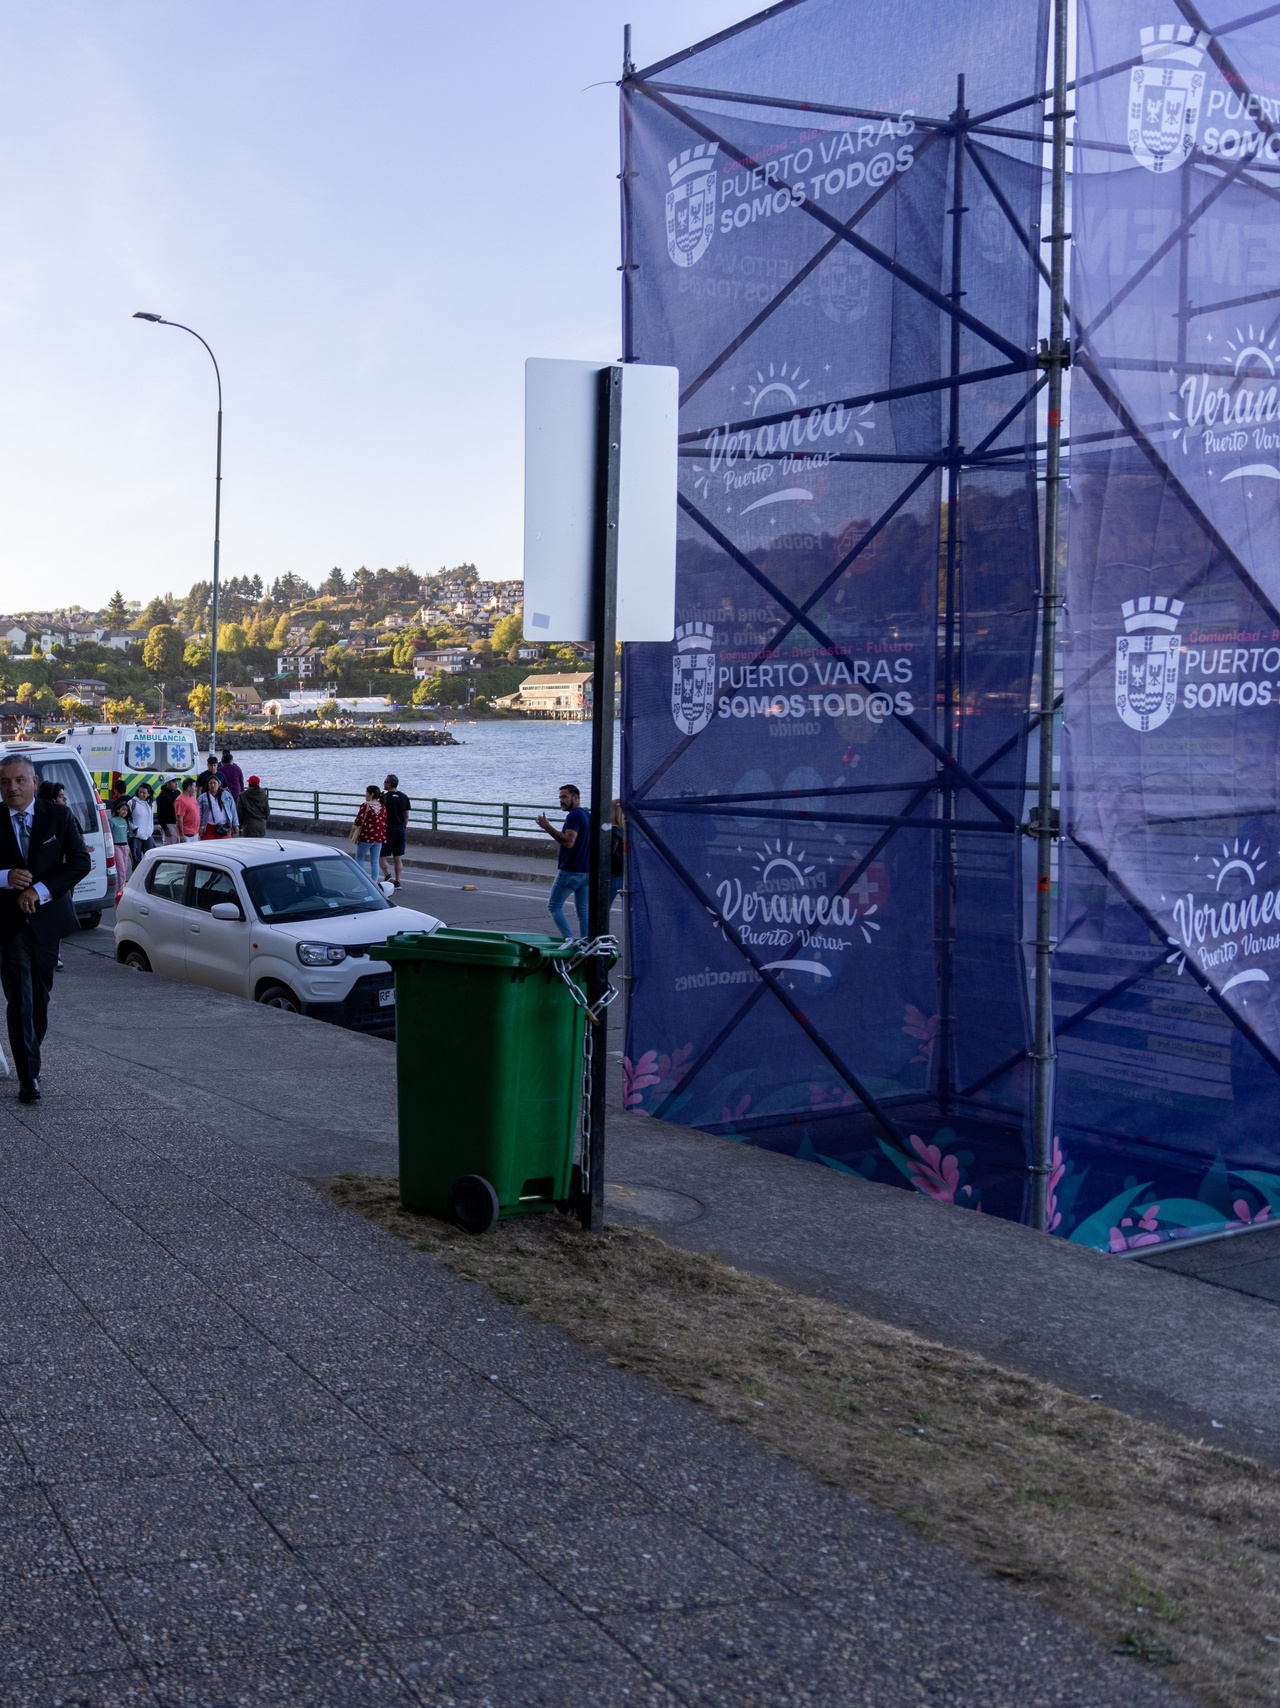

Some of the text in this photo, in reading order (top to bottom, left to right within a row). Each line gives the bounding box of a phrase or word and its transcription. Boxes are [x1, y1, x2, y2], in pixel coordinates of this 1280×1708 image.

[721, 109, 915, 203] PUERTO VARAS
[720, 144, 914, 234] SOMOS TOD@S
[705, 402, 852, 473] Veranea
[1202, 429, 1249, 454] Puerto
[723, 451, 841, 493] Puerto Varas
[719, 646, 780, 661] Comunidad
[791, 644, 852, 658] Bienestar
[866, 641, 913, 654] Futuro
[1189, 629, 1260, 643] Comunidad
[718, 658, 913, 688] PUERTO VARAS
[1185, 647, 1280, 675] PUERTO
[718, 691, 914, 723] SOMOS TOD@S
[1183, 681, 1272, 709] SOMOS
[133, 734, 187, 742] AMBULANCIA
[716, 878, 857, 926] Veranea
[1173, 889, 1280, 947] Verane
[738, 924, 852, 951] Puerto Varas
[1197, 941, 1238, 971] Puerto
